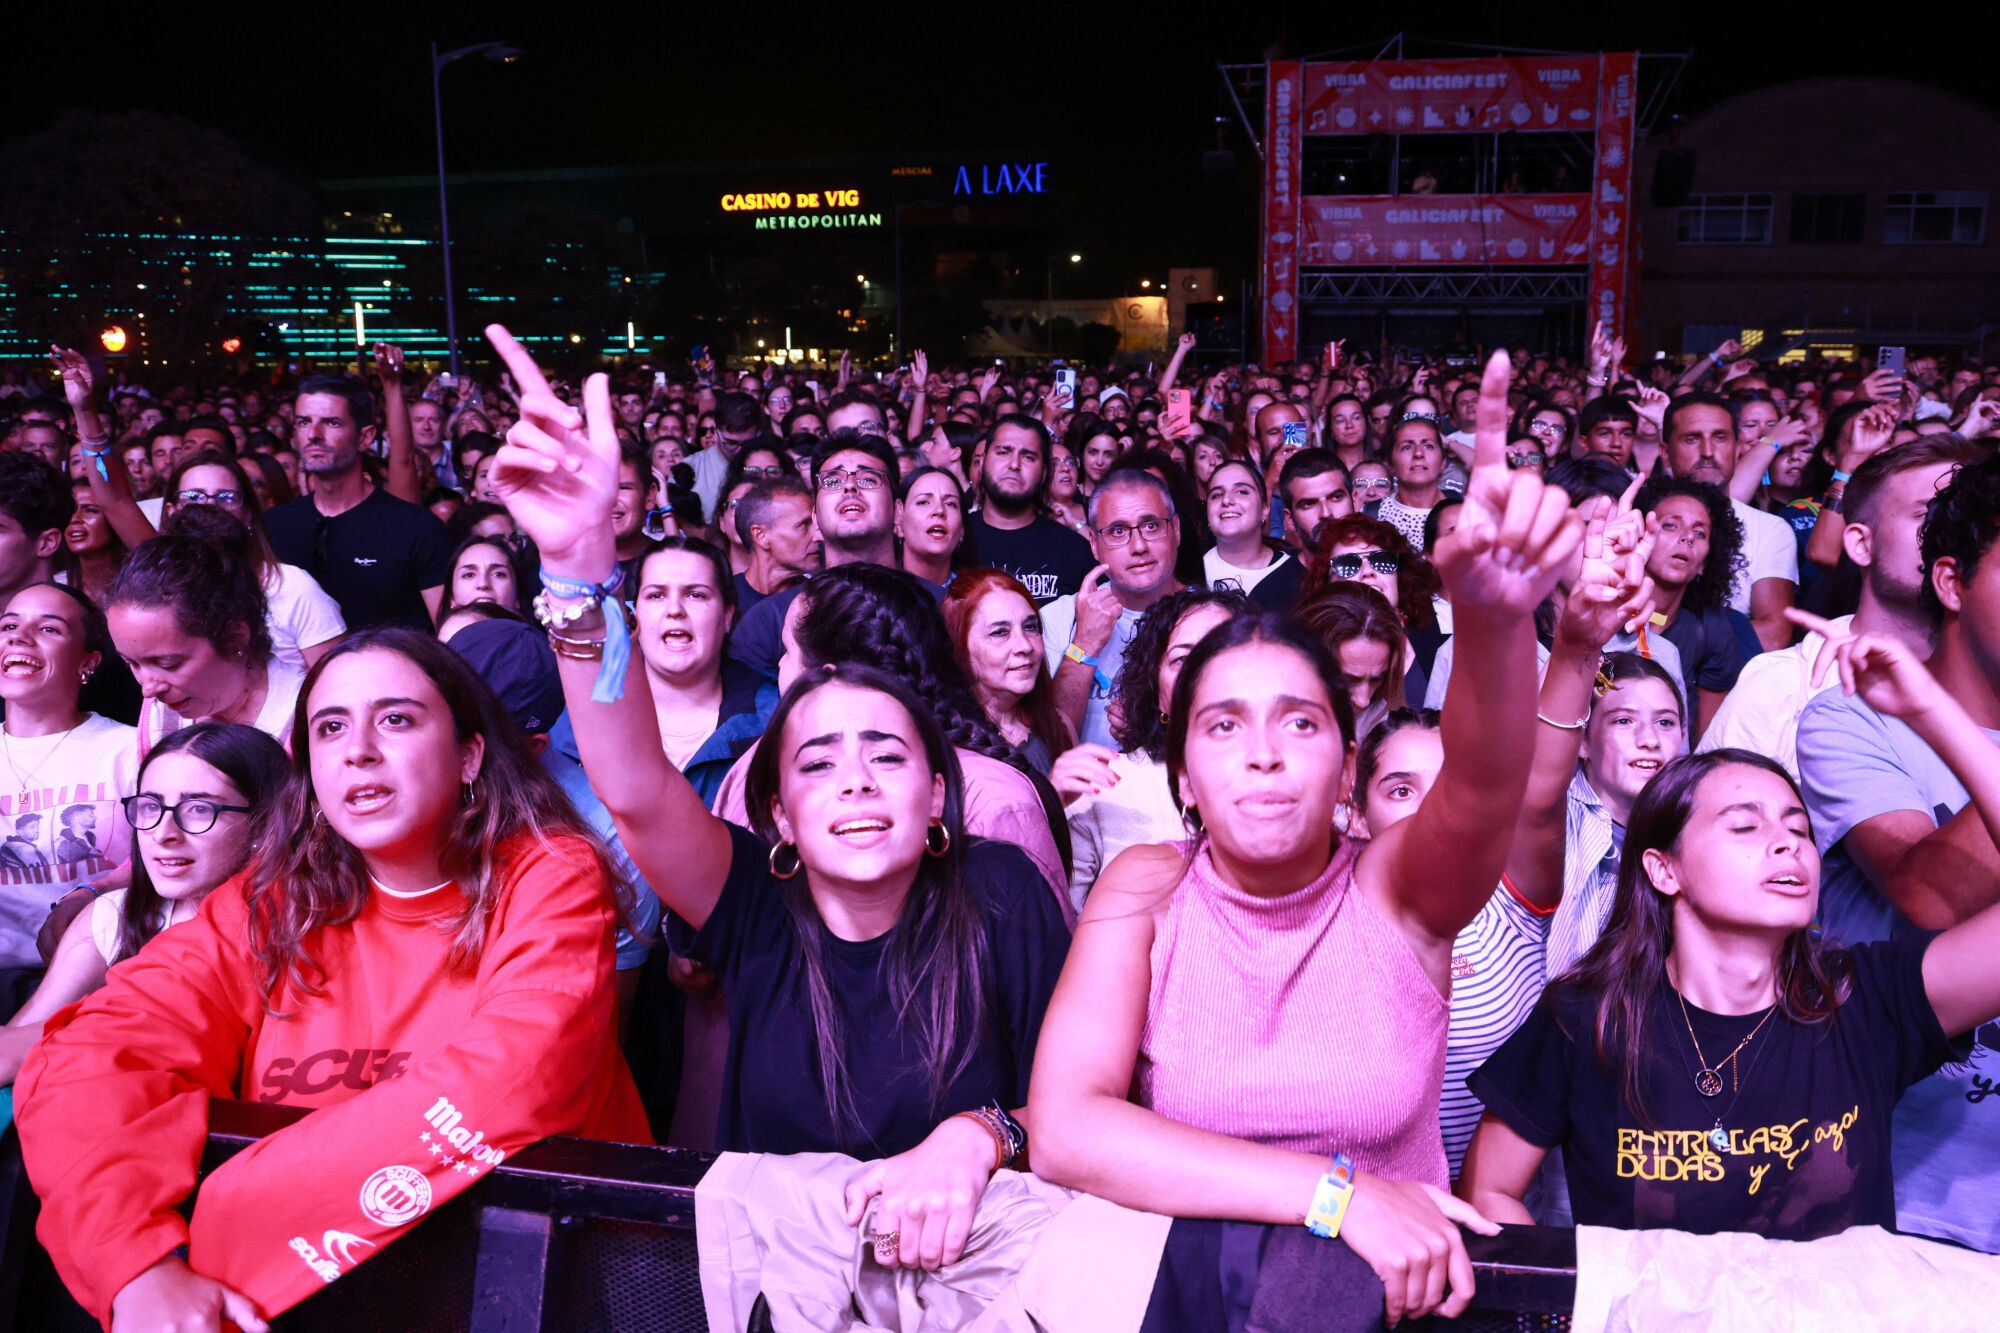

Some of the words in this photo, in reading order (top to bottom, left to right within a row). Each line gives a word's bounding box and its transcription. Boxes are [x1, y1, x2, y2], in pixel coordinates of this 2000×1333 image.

[1324, 73, 1367, 87] VIBRA
[1389, 73, 1509, 91] GALICIAFEST
[1538, 69, 1581, 83] VIBRA
[953, 165, 972, 194] A
[982, 162, 1049, 195] LAXE
[721, 192, 791, 211] CASINO
[796, 193, 820, 208] DE
[824, 189, 859, 207] VIG
[1320, 206, 1362, 221] VIBRA
[1385, 208, 1504, 224] GALICIAFEST
[1534, 204, 1577, 218] VIBRA
[755, 213, 882, 230] METROPOLITAN
[1014, 574, 1058, 597] NDEZ
[1616, 1153, 1725, 1182] DUDAS
